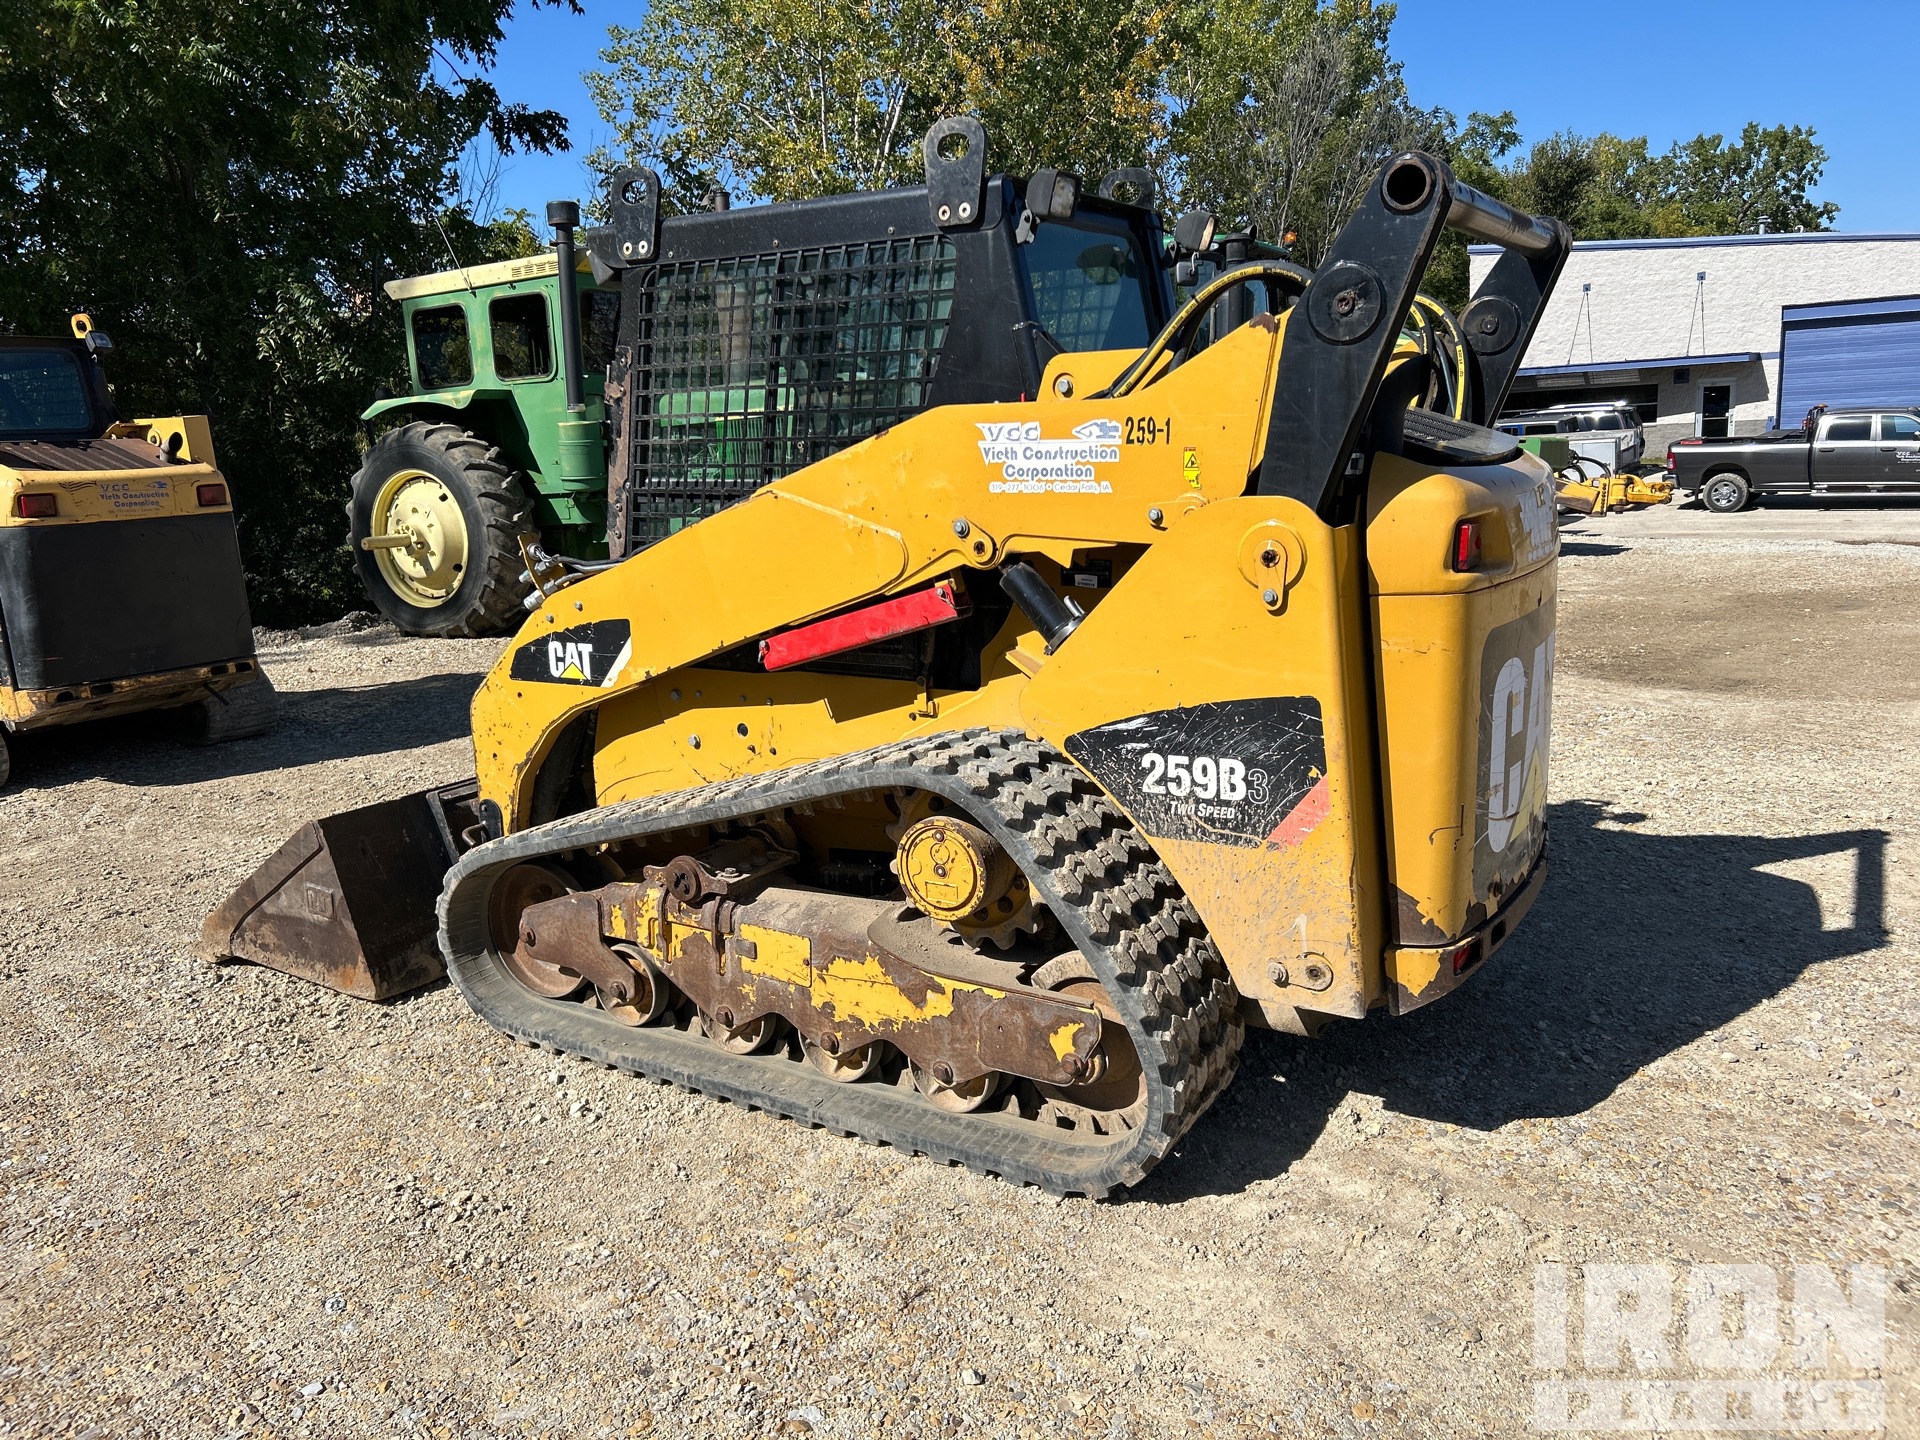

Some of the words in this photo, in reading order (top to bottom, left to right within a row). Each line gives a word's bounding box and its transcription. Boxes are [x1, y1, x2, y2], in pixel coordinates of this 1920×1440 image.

[1125, 416, 1171, 446] 259-1
[983, 446, 1018, 460] Vieth
[1022, 445, 1118, 461] Construction
[1004, 463, 1093, 481] Corporation
[1054, 482, 1079, 491] Cedar
[1102, 483, 1110, 491] IA
[122, 491, 170, 500] Construction
[114, 500, 160, 509] Corporation
[548, 640, 593, 681] CAT
[1488, 630, 1555, 853] CA
